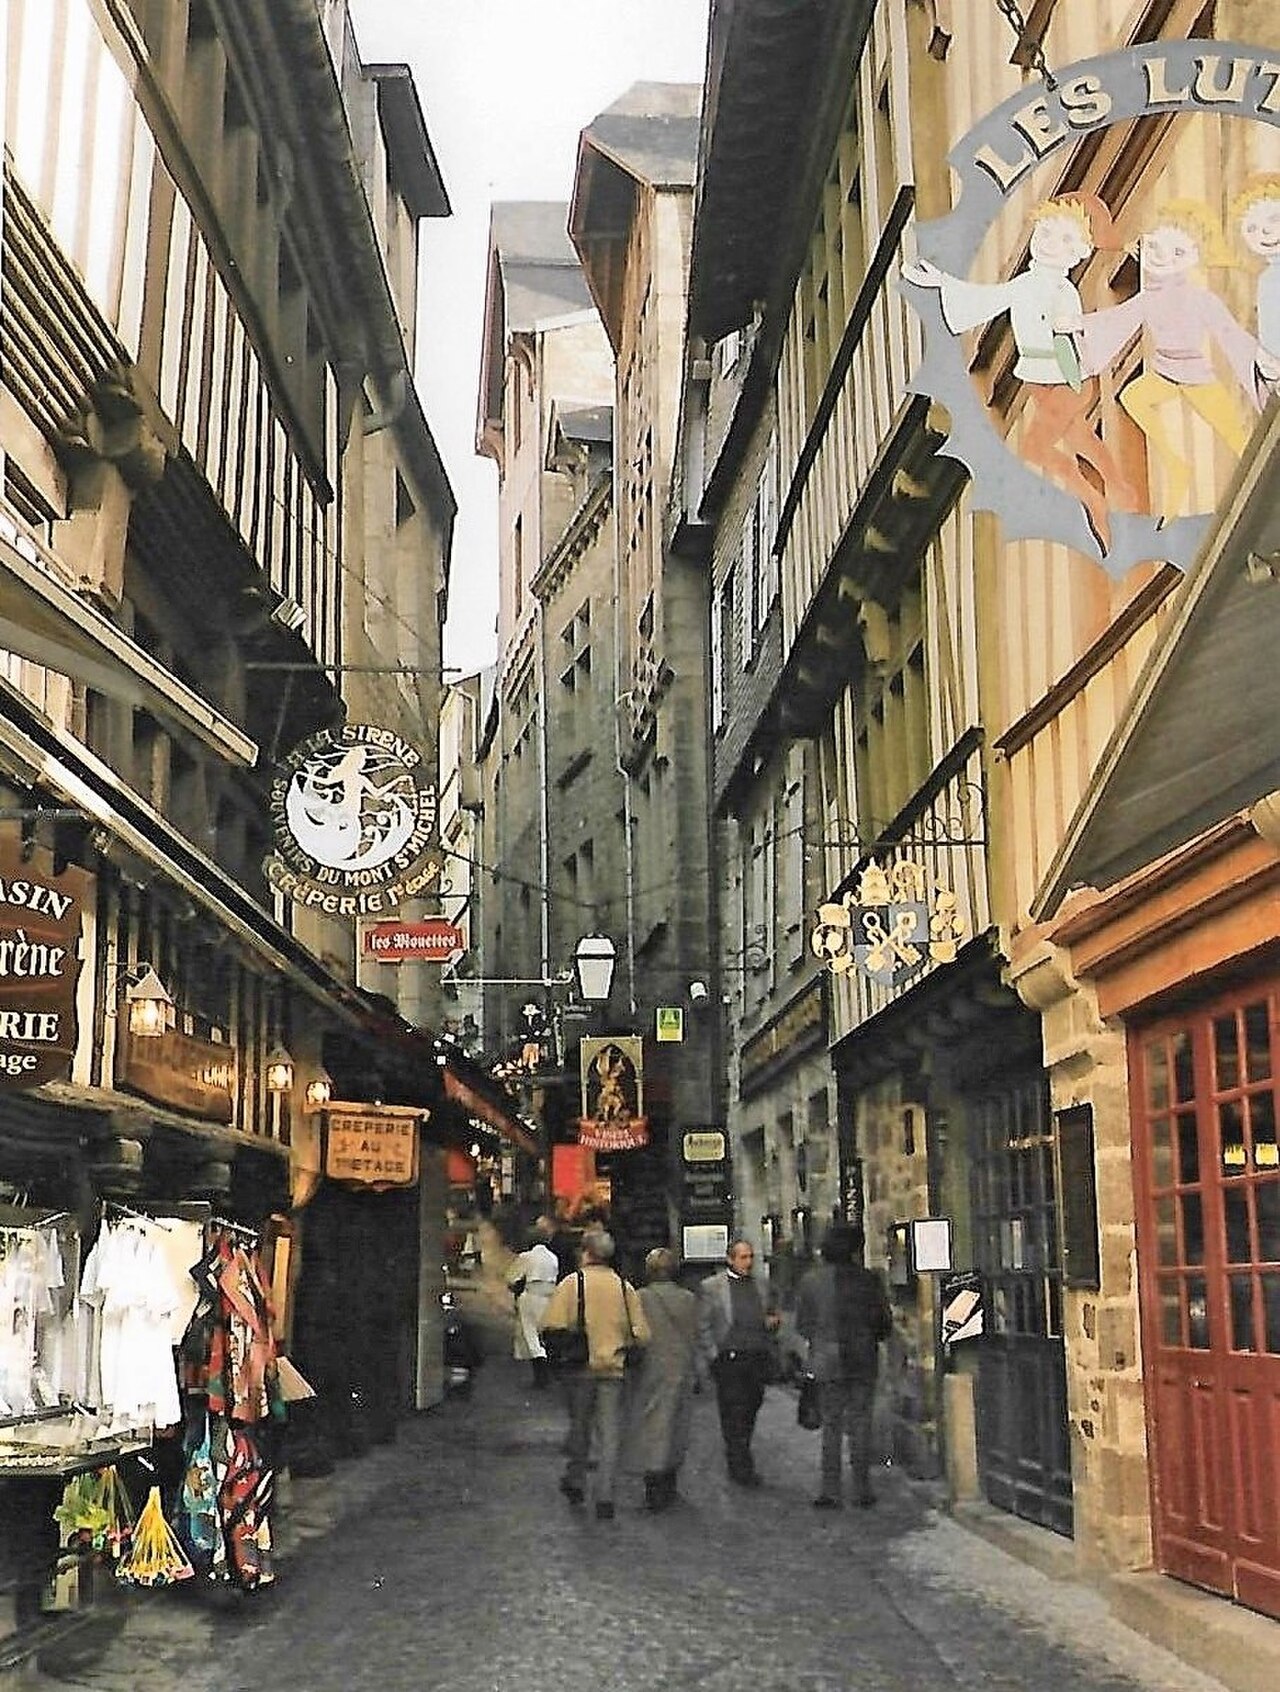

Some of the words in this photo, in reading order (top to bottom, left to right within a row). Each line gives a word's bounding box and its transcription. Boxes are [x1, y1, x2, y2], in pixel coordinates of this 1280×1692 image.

[975, 76, 1112, 195] LES
[316, 866, 340, 885] DU
[344, 862, 394, 887] MONT
[405, 784, 437, 856] MICHEL
[0, 879, 74, 920] SIN
[393, 932, 457, 949] Mouettes
[0, 1010, 59, 1042] RIE
